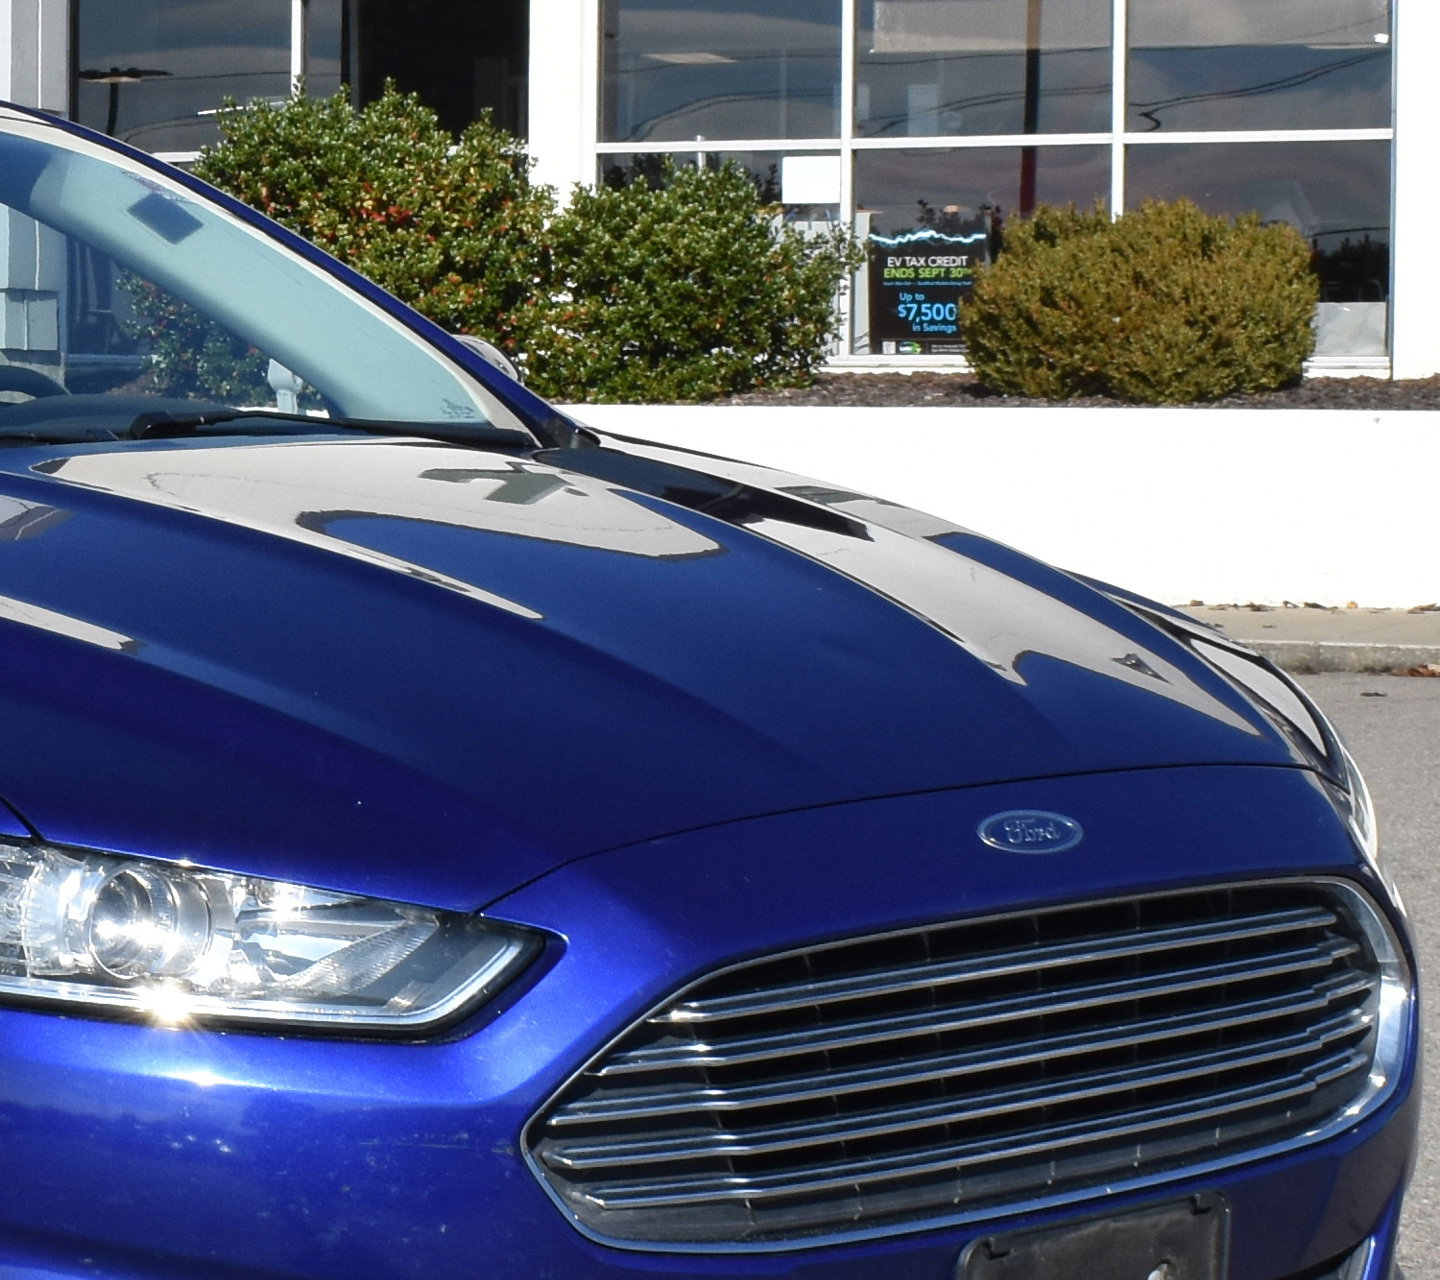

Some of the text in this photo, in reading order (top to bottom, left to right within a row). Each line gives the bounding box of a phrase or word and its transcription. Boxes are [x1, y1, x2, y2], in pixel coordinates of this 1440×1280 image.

[888, 256, 968, 266] EV TAX CREDIT
[884, 268, 915, 278] ENDS
[918, 268, 945, 278] SEPT
[899, 292, 925, 302] Up to
[923, 323, 957, 334] Savings
[1004, 818, 1061, 844] Ford
